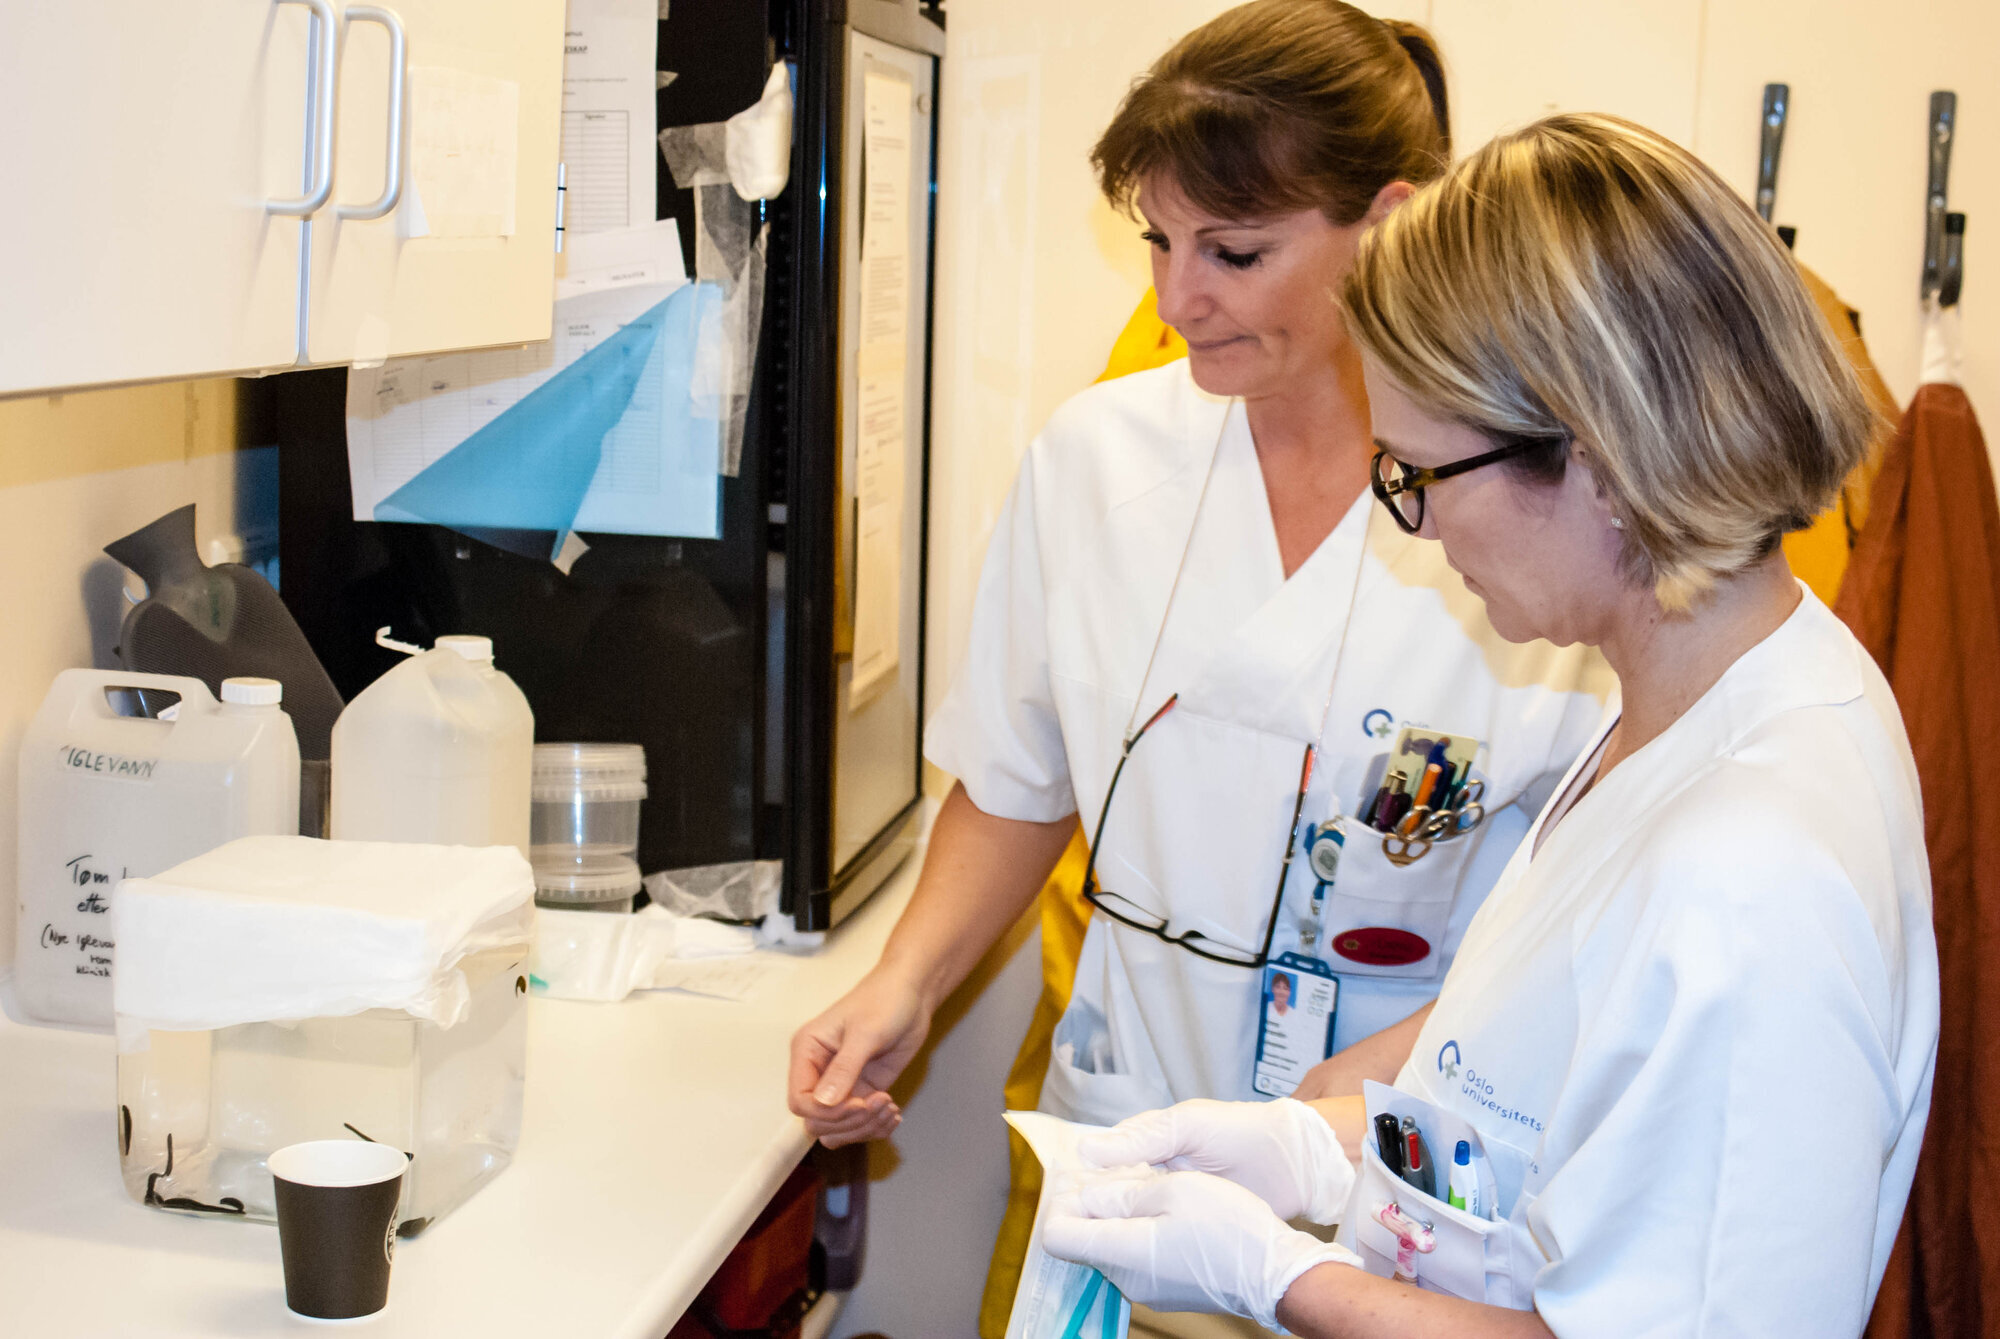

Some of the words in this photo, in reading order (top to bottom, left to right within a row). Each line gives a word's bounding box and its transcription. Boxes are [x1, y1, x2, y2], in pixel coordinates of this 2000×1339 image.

[66, 747, 157, 778] IGLEVANN
[1466, 1069, 1494, 1095] Oslo
[1462, 1083, 1545, 1132] universitets
